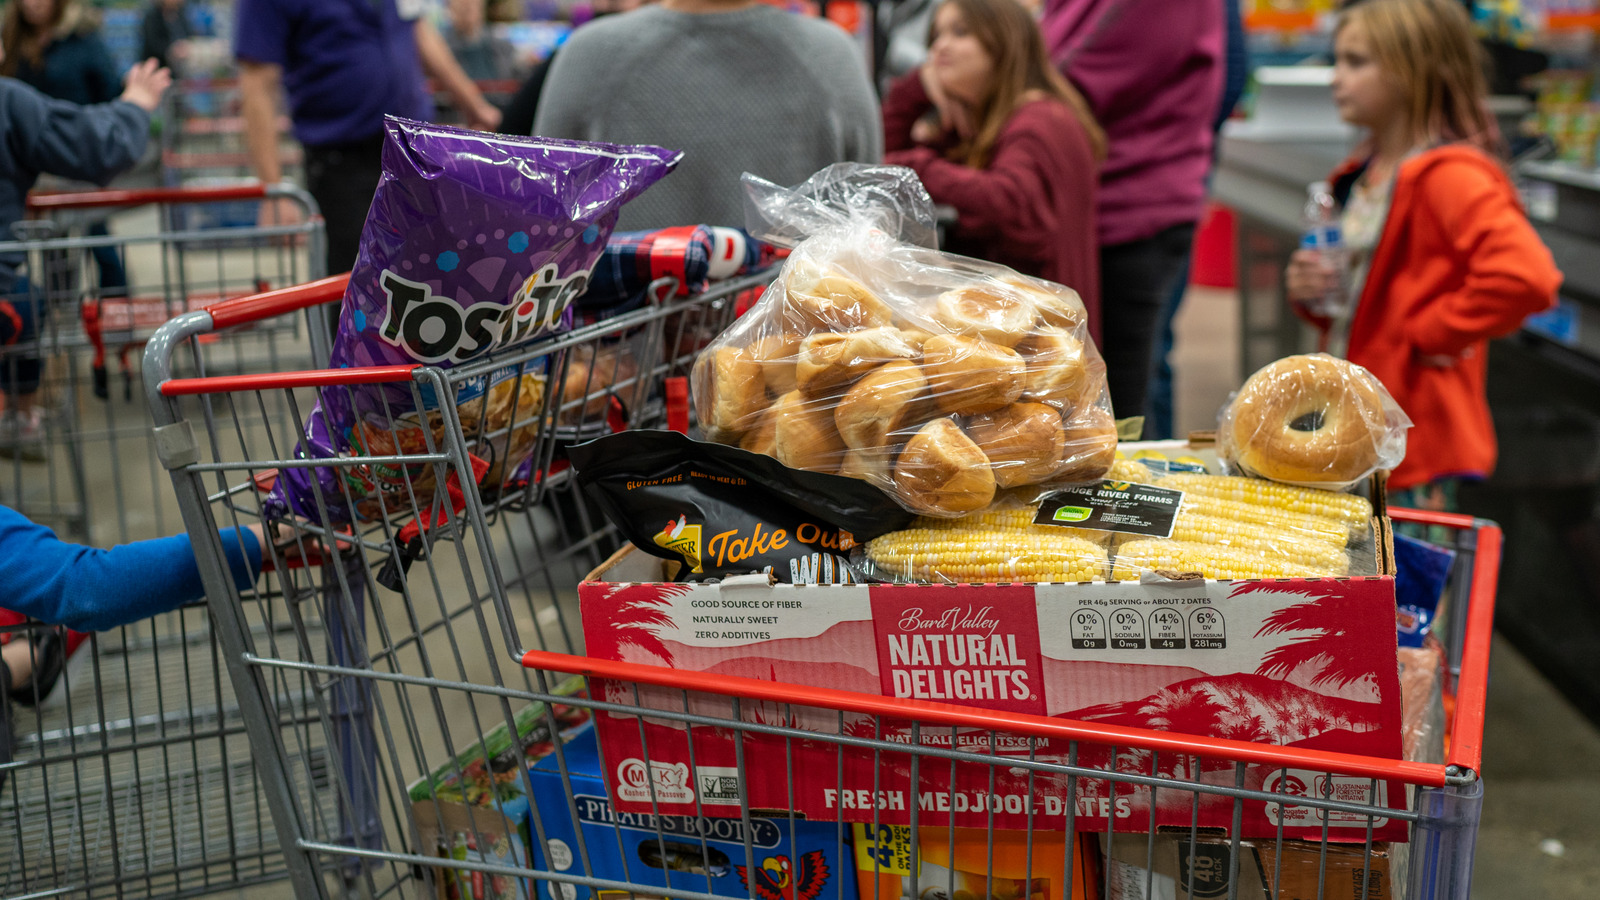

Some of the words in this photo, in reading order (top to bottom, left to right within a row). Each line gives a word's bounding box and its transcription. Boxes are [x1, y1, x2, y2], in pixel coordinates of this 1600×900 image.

[626, 479, 659, 491] GLUTEN
[661, 474, 683, 484] FREE
[717, 476, 730, 484] HEAT
[1062, 487, 1094, 496] OUGE
[1097, 490, 1130, 500] RIVER
[1134, 493, 1173, 505] FARMS
[708, 522, 789, 568] Take
[796, 522, 842, 551] Ou
[691, 600, 720, 608] GOOD
[722, 600, 760, 609] SOURCE
[761, 600, 775, 609] OF
[777, 601, 802, 609] FIBER
[1094, 599, 1108, 607] 46g
[693, 616, 745, 624] NATURALLY
[747, 616, 778, 624] SWEET
[898, 607, 954, 632] Bard
[945, 604, 1000, 641] Valley
[1077, 613, 1097, 625] 0%
[1116, 613, 1137, 625] 0%
[1154, 613, 1179, 624] 14%
[1196, 612, 1217, 624] 6%
[695, 631, 719, 639] ZERO
[721, 631, 771, 640] ADDITIVES
[887, 634, 1026, 667] NATURAL
[1083, 640, 1095, 648] 0g
[1119, 640, 1138, 648] 0mg
[1162, 640, 1174, 648] 4g
[1194, 640, 1222, 648] 281mg
[892, 669, 1031, 700] DELIGHTS
[631, 770, 645, 783] M
[660, 770, 671, 783] K
[624, 789, 646, 797] Kosher
[658, 789, 686, 799] Passover
[823, 788, 905, 811] FRESH
[917, 792, 1038, 815] MEDJOOL
[1045, 796, 1131, 818] DATES
[1272, 808, 1308, 816] Crugated
[683, 816, 762, 844] BOOTY
[864, 823, 894, 868] 45
[895, 841, 903, 856] THE
[897, 857, 904, 870] ON
[1185, 855, 1214, 883] 48
[1213, 856, 1223, 883] PACK
[1352, 868, 1364, 900] ACKAGES
